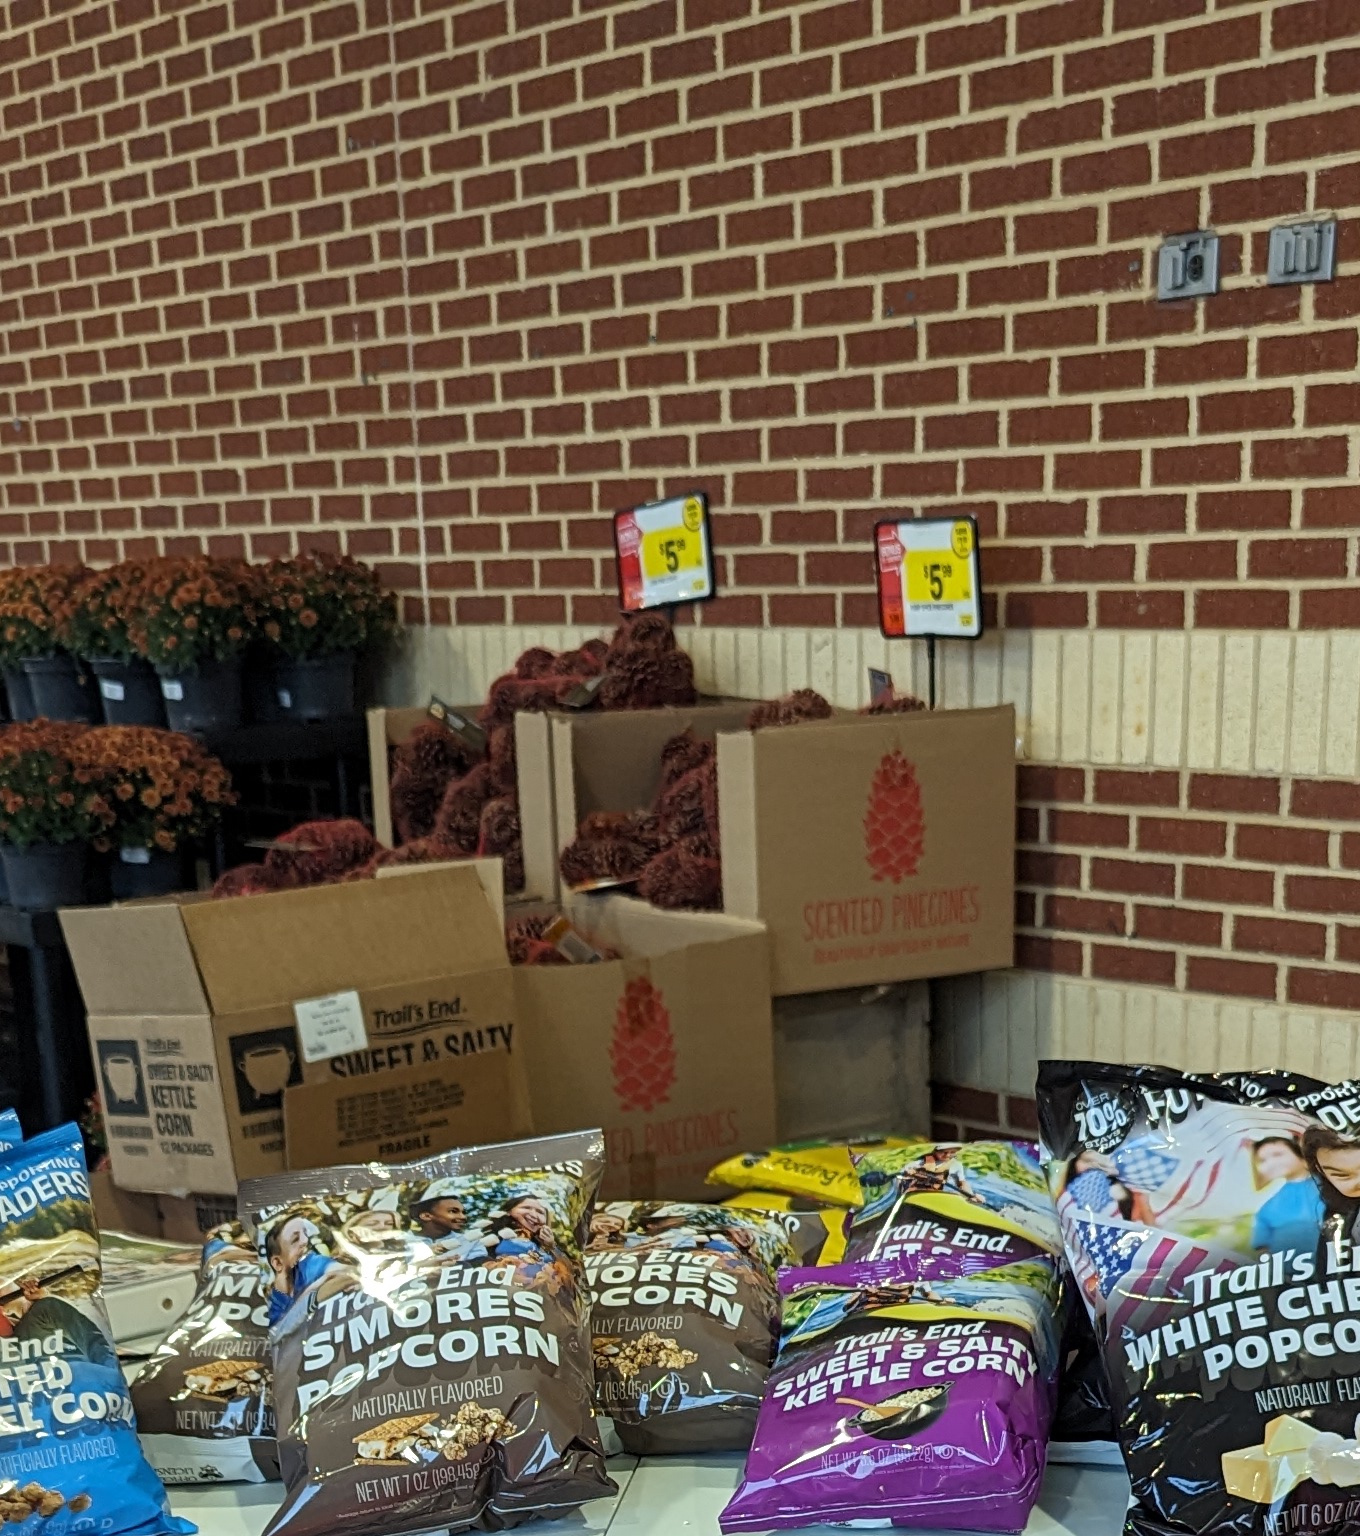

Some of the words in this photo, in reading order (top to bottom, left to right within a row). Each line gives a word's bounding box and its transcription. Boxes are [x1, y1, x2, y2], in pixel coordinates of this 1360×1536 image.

[803, 897, 883, 942] SCENTED
[891, 885, 980, 932] PINECONES
[372, 1003, 424, 1032] Trail's
[427, 996, 463, 1024] End
[150, 1085, 197, 1111] KETTLE
[154, 1112, 194, 1138] CORN
[1074, 1099, 1128, 1142] 70%
[378, 1133, 432, 1157] FRAGILE
[1184, 1249, 1315, 1307] Trail's
[303, 1288, 546, 1372] S'MORES
[835, 1326, 917, 1354] Trail's
[923, 1321, 986, 1341] End
[1124, 1295, 1268, 1373] WHITE
[297, 1325, 560, 1415] POPCORN
[773, 1344, 891, 1399] SWEET
[901, 1343, 927, 1359] &
[938, 1336, 1038, 1376] SALTY
[783, 1362, 912, 1412] KETTLE
[922, 1354, 1026, 1387] CORN
[352, 1388, 427, 1421] NATURALLY
[431, 1376, 503, 1406] FLAVORED
[1255, 1380, 1331, 1414] NATURALLY
[1290, 1504, 1307, 1528] WT
[1311, 1504, 1320, 1525] 6
[1324, 1503, 1343, 1524] OZ
